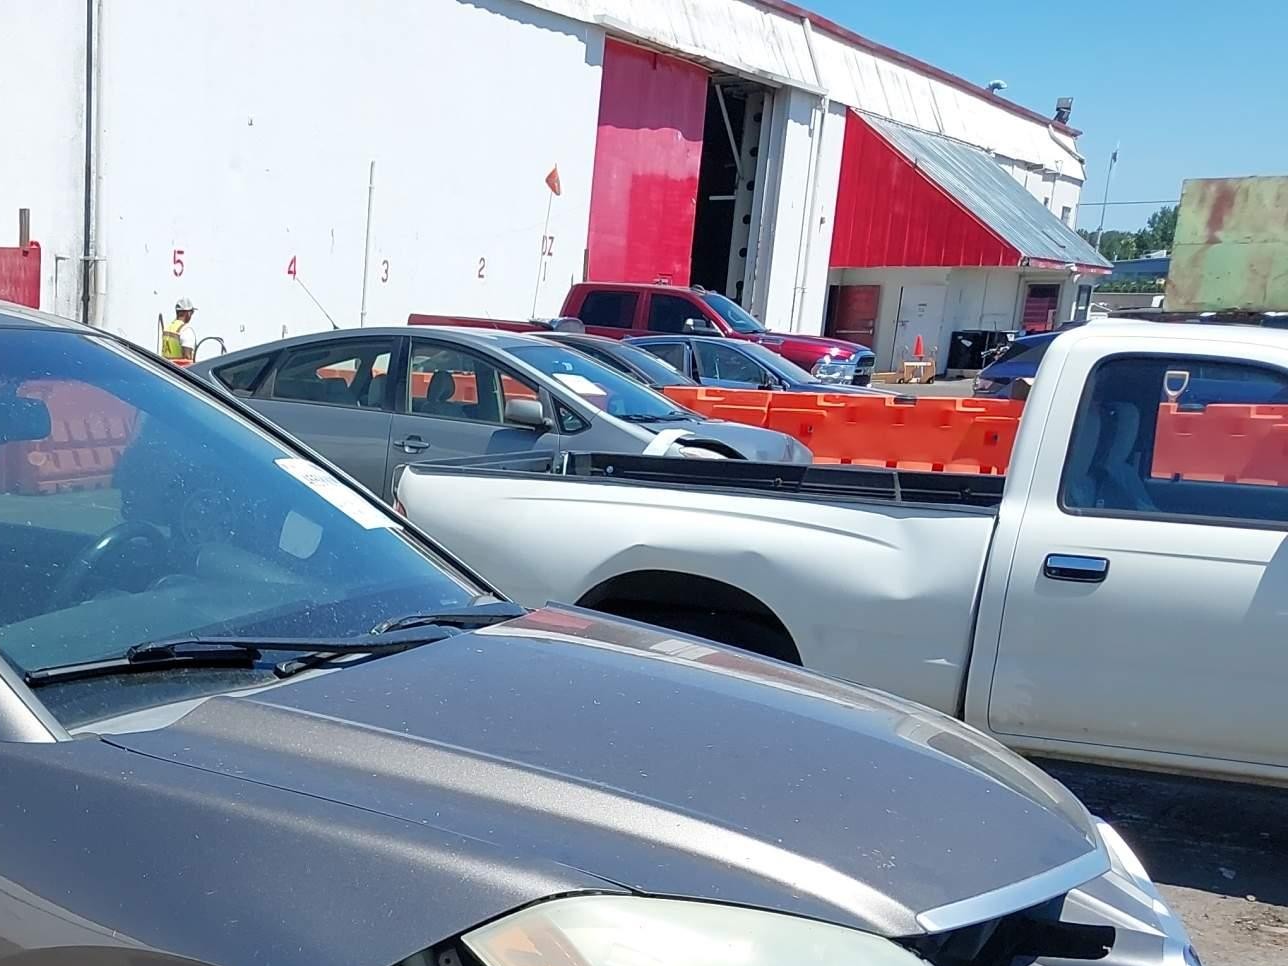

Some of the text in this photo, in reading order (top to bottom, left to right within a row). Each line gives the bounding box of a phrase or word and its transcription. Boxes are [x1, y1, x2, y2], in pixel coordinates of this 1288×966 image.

[172, 249, 185, 277] 5
[287, 255, 297, 280] 4
[381, 259, 390, 283] 3
[477, 256, 486, 279] 2
